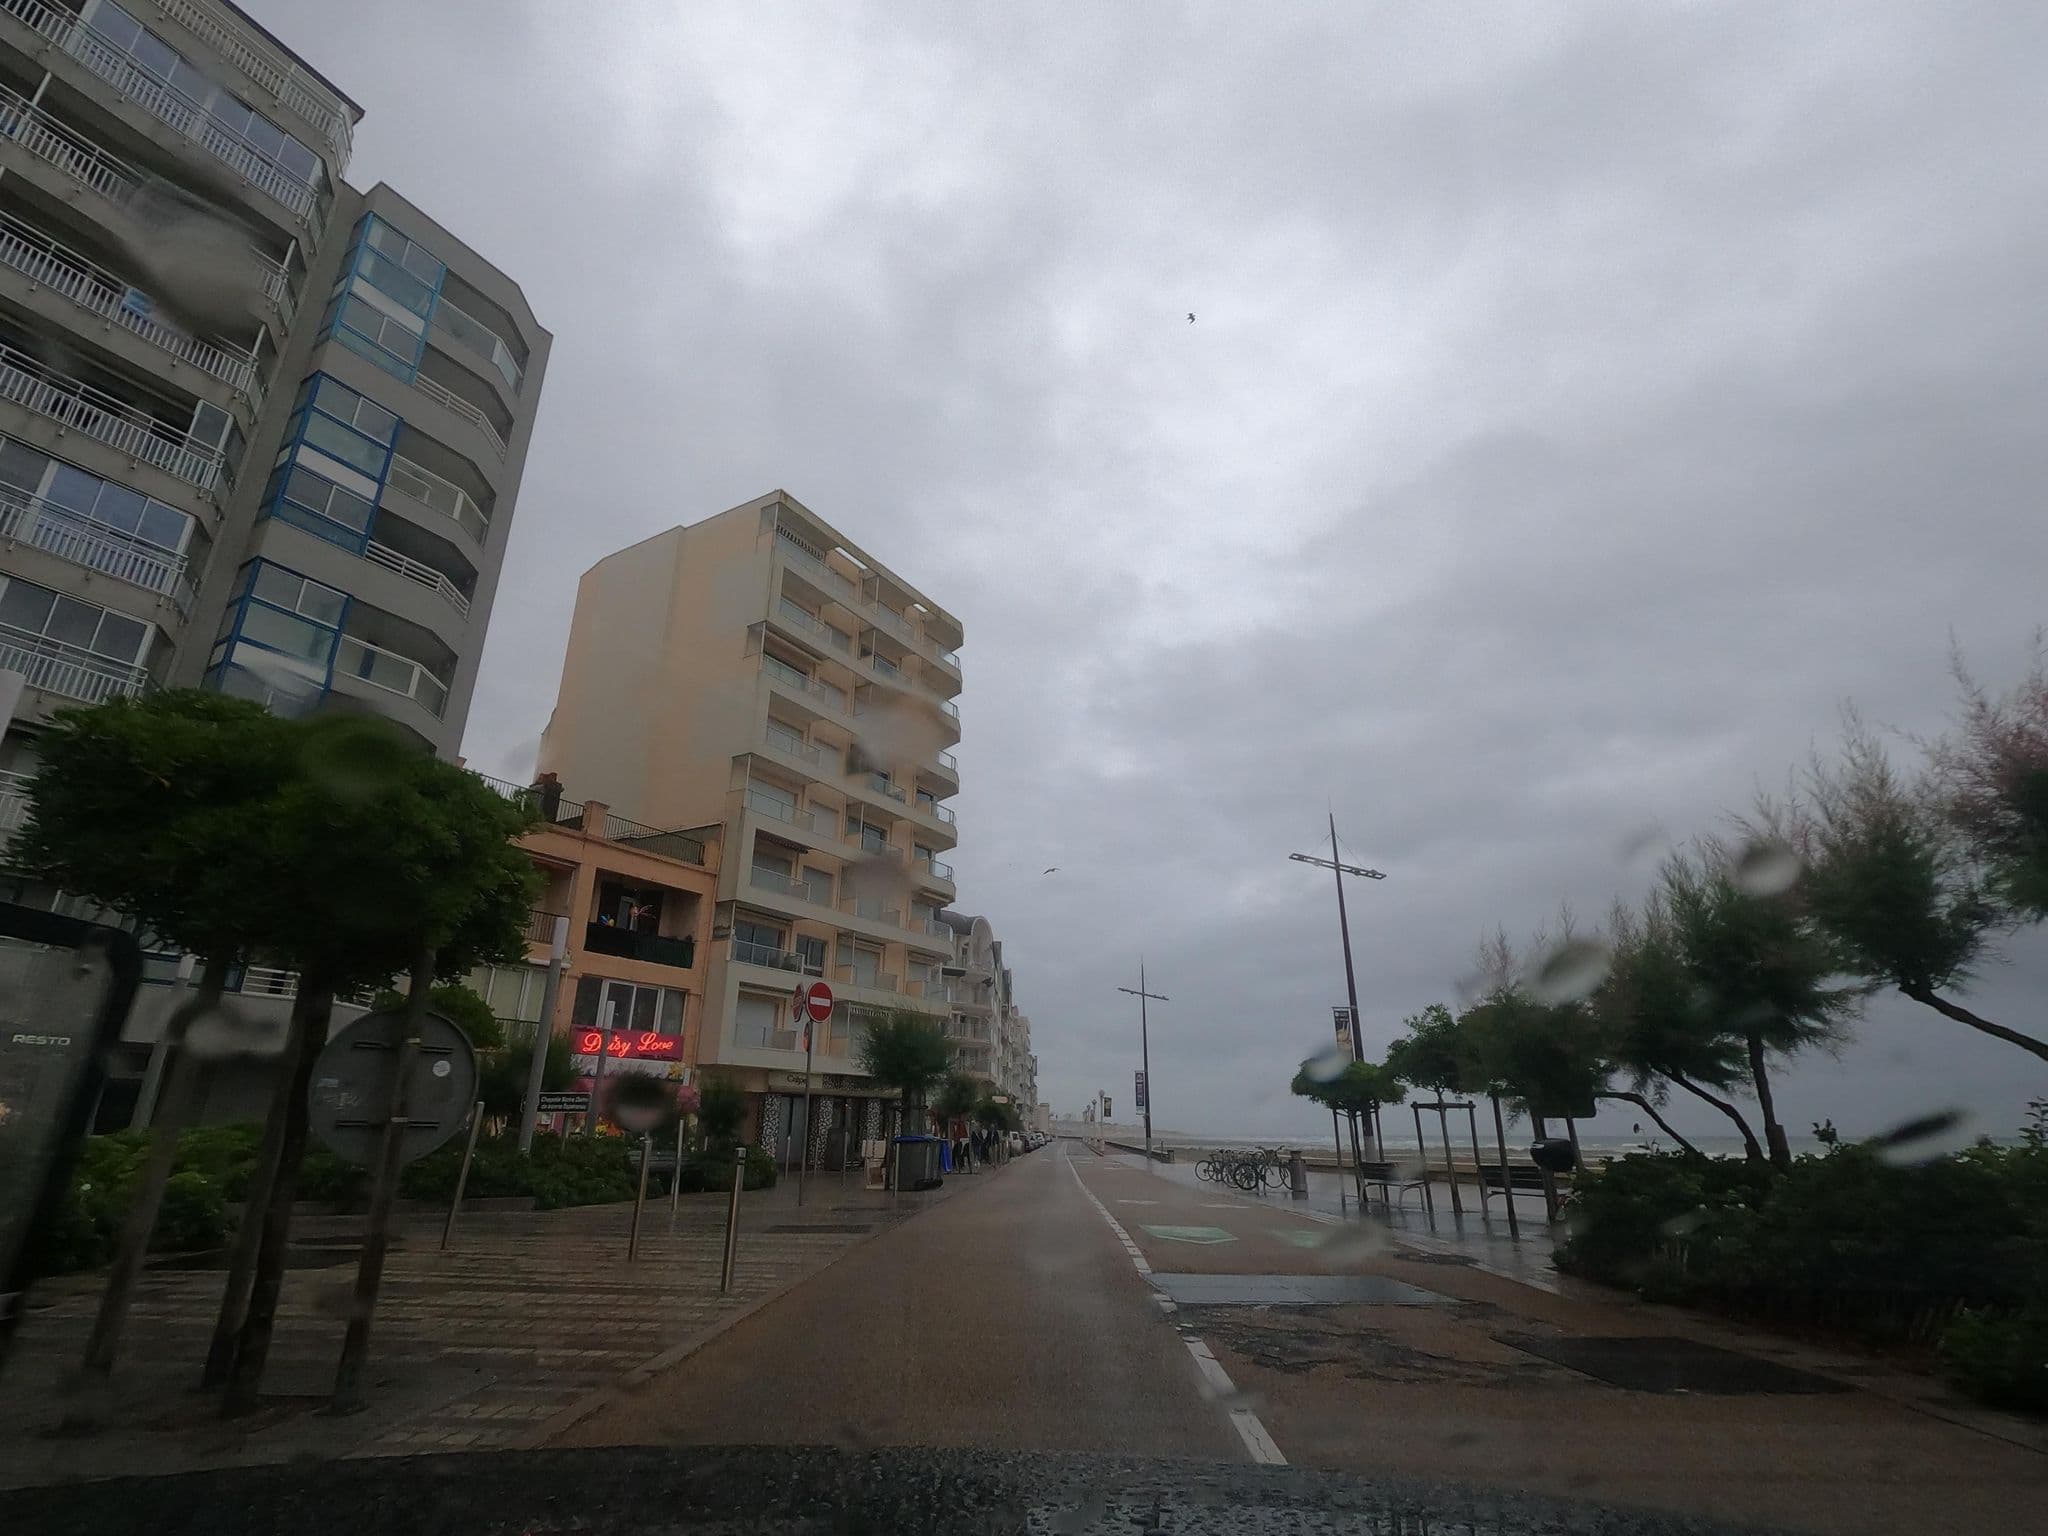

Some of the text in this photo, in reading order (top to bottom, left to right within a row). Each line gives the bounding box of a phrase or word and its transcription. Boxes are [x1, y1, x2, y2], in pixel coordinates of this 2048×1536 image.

[12, 1034, 72, 1046] RESTO
[582, 1032, 673, 1058] Disy Love
